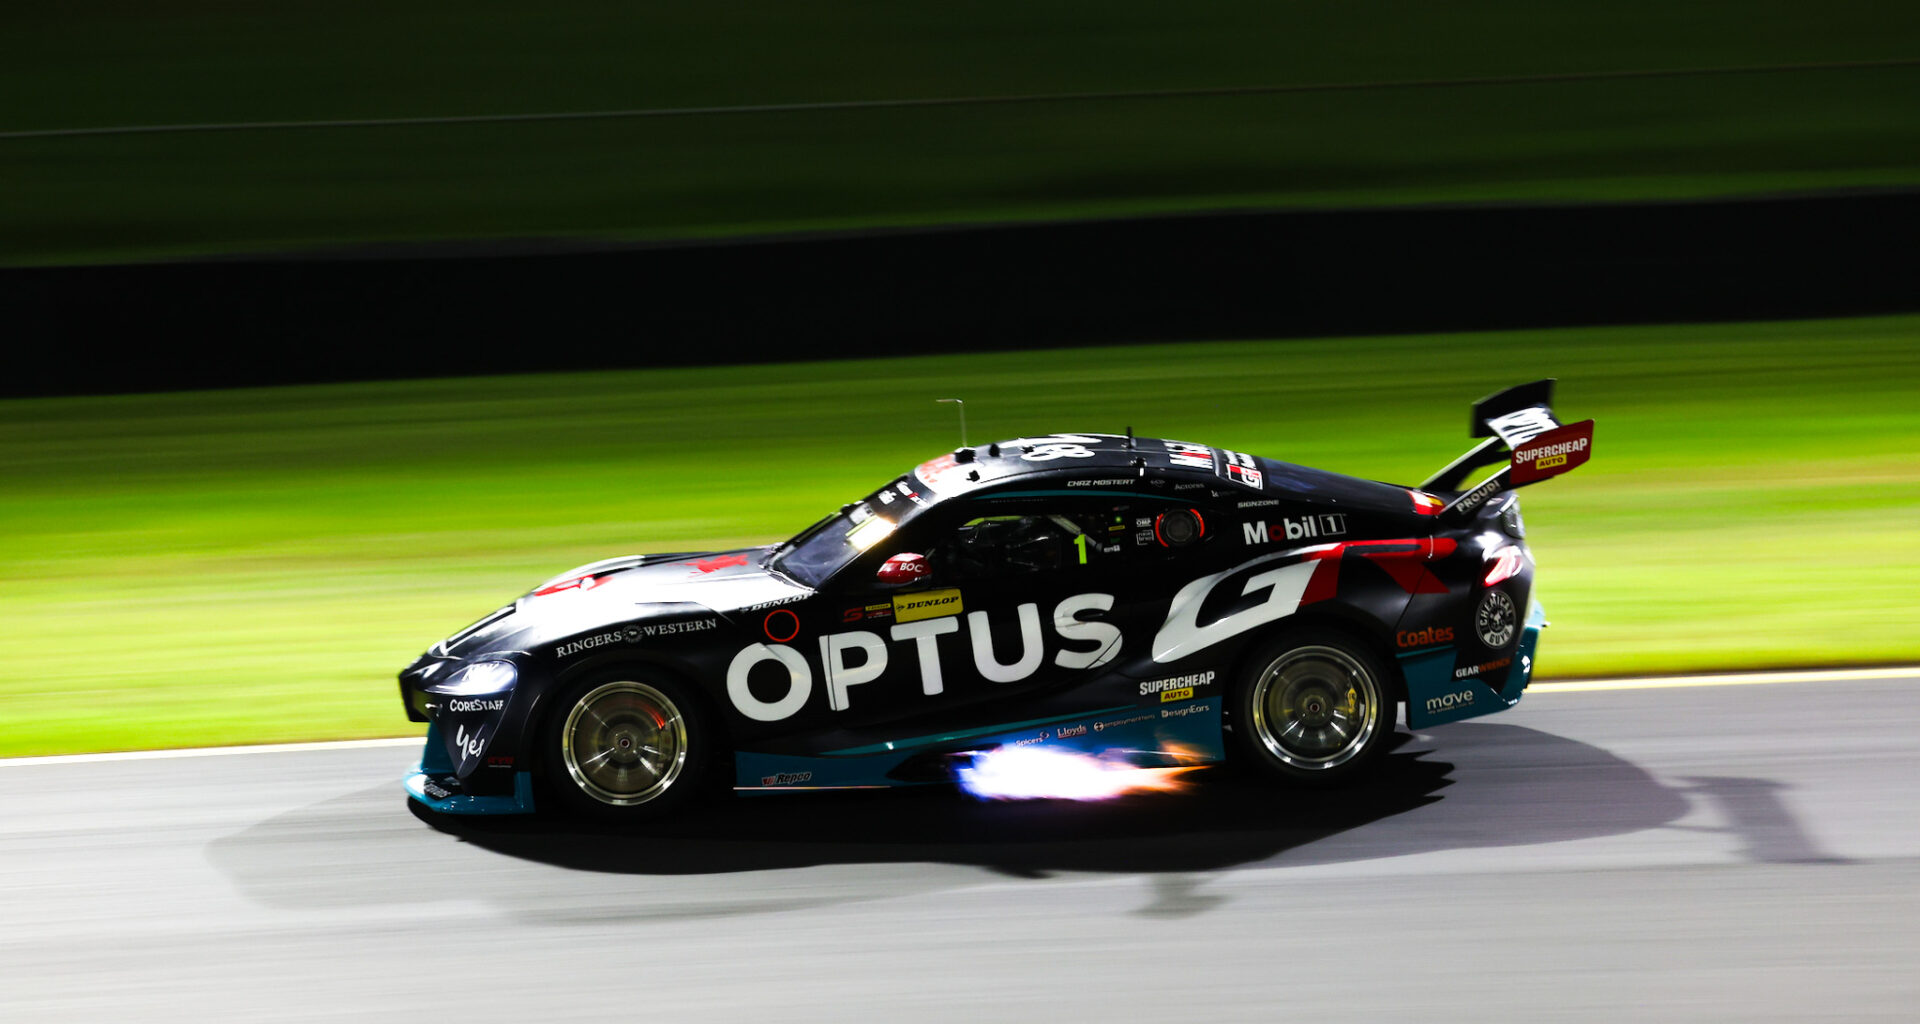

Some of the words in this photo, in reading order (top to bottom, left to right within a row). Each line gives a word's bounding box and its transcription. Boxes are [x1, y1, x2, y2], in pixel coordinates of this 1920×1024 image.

[1515, 438, 1588, 464] SUPERCHEAP
[1539, 457, 1564, 468] AUTO
[1243, 516, 1317, 545] Mobil
[1074, 533, 1088, 564] 1
[900, 562, 924, 573] BOC
[907, 596, 960, 610] DUNLOP
[556, 631, 623, 658] RINGERS
[643, 618, 717, 636] WESTERN
[1397, 626, 1454, 648] Coates
[727, 593, 1123, 722] OPTUS
[1140, 671, 1215, 696] SUPERCHEAP
[1164, 689, 1190, 700] AUTO
[1426, 690, 1473, 710] move
[456, 724, 485, 761] Yes
[775, 771, 812, 784] Repco
